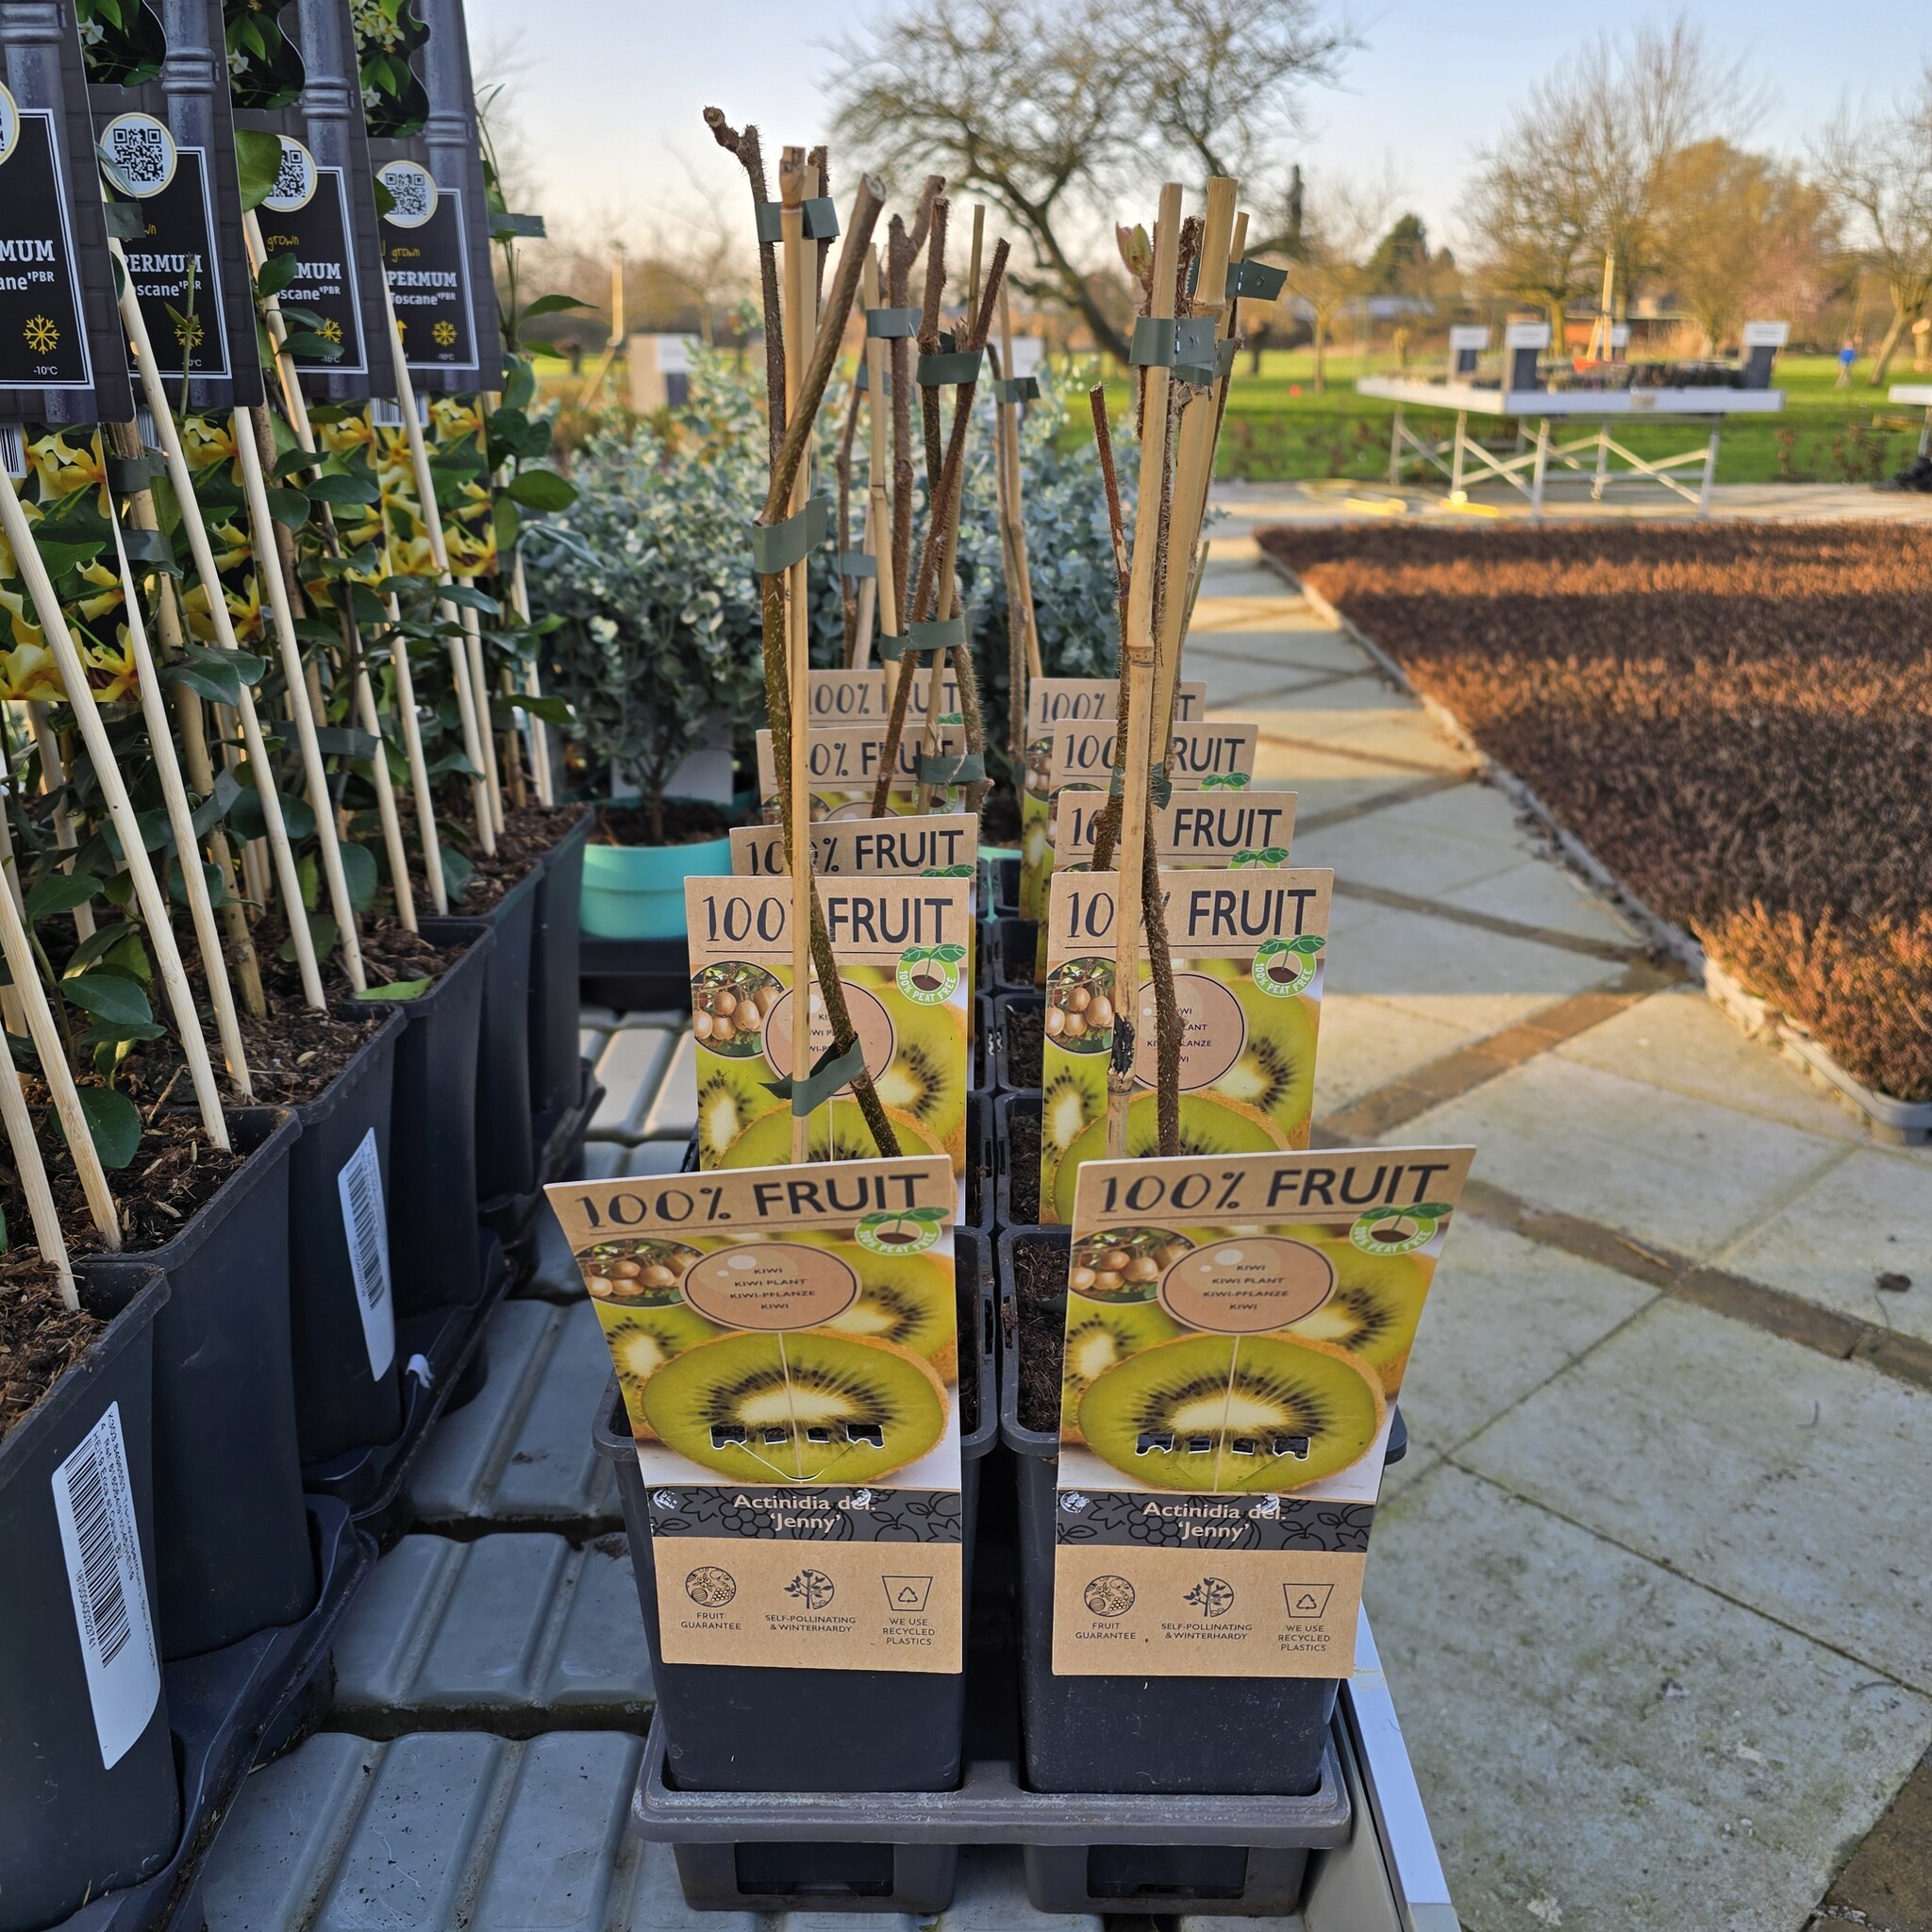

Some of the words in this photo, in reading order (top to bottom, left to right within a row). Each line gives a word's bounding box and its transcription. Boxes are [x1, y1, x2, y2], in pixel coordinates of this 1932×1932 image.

[267, 235, 300, 252] grown
[391, 248, 421, 262] grown
[33, 366, 58, 375] -10°C
[1064, 734, 1117, 769] 100
[1174, 737, 1245, 773] RUIT
[1174, 808, 1282, 847] FRUIT
[746, 836, 839, 875] 10%
[856, 830, 964, 869] FRUIT
[1188, 890, 1317, 936] FRUIT
[703, 896, 794, 941] 100
[827, 897, 953, 943] FRUIT
[1266, 983, 1290, 993] PEAT
[1292, 969, 1313, 992] FREE
[912, 991, 936, 1002] PEAT
[937, 976, 957, 1002] FREE
[1100, 1171, 1245, 1212] 100%
[1266, 1164, 1450, 1207] FRUIT
[576, 1187, 731, 1227] 100%
[753, 1173, 929, 1217] FRUIT
[878, 1244, 908, 1253] PEAT
[1367, 1243, 1398, 1253] PEAT
[730, 1290, 815, 1299] KIWI-PFLANZE
[734, 1494, 831, 1510] Actinidia
[1142, 1502, 1241, 1520] Actinidia
[765, 1614, 857, 1624] SELF-POLLINATING
[908, 1618, 928, 1626] USE
[680, 1622, 741, 1630] GUARANTEE
[778, 1624, 853, 1633] WINTERHARDY
[882, 1626, 936, 1636] RECYCLED
[1161, 1623, 1253, 1632] SELF-POLLINATING
[1286, 1624, 1303, 1633] WE
[1306, 1624, 1324, 1633] USE
[1074, 1631, 1137, 1641] GUARANTEE
[1174, 1631, 1249, 1641] WINTERHARDY
[1277, 1633, 1331, 1643] RECYCLED
[886, 1637, 932, 1646] PLASTICS
[1280, 1643, 1326, 1652] PLASTICS
